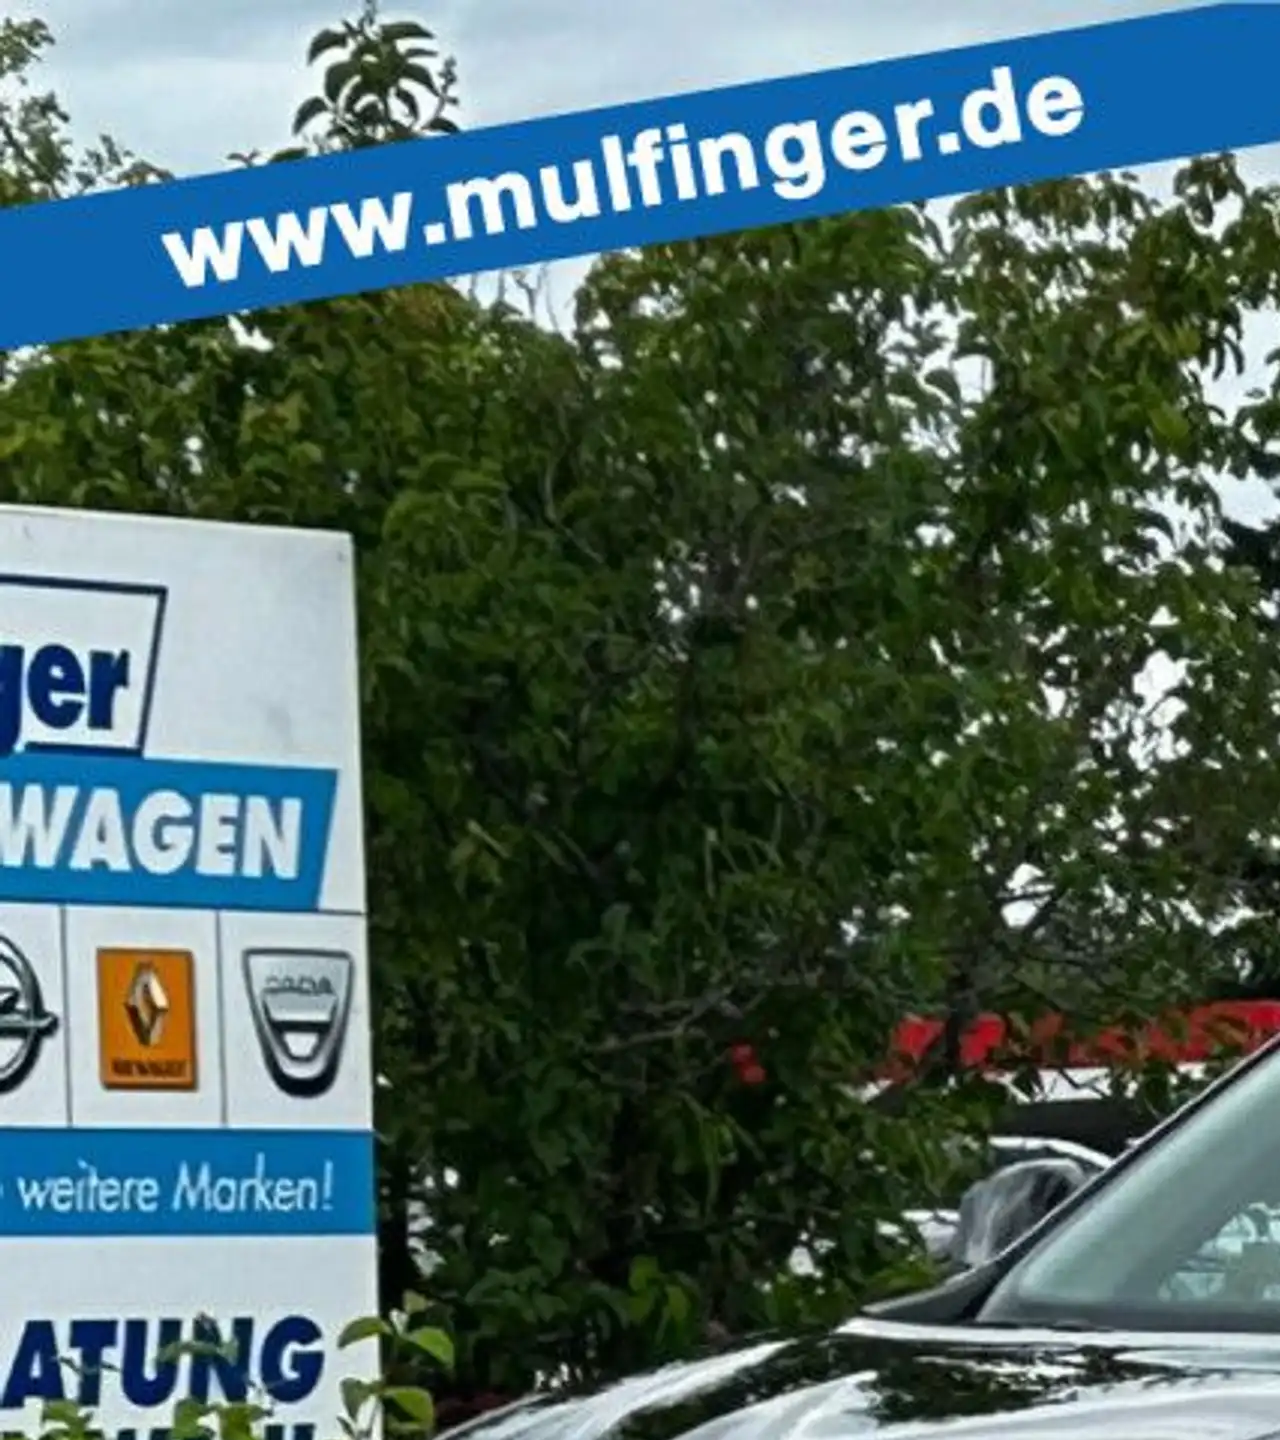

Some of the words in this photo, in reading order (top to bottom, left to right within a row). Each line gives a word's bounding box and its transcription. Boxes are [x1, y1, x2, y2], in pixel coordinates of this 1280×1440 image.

[0, 781, 303, 880] WAGEN
[17, 1160, 158, 1213] weitere
[172, 1153, 334, 1213] Marken!
[0, 1315, 325, 1408] ATUNG
